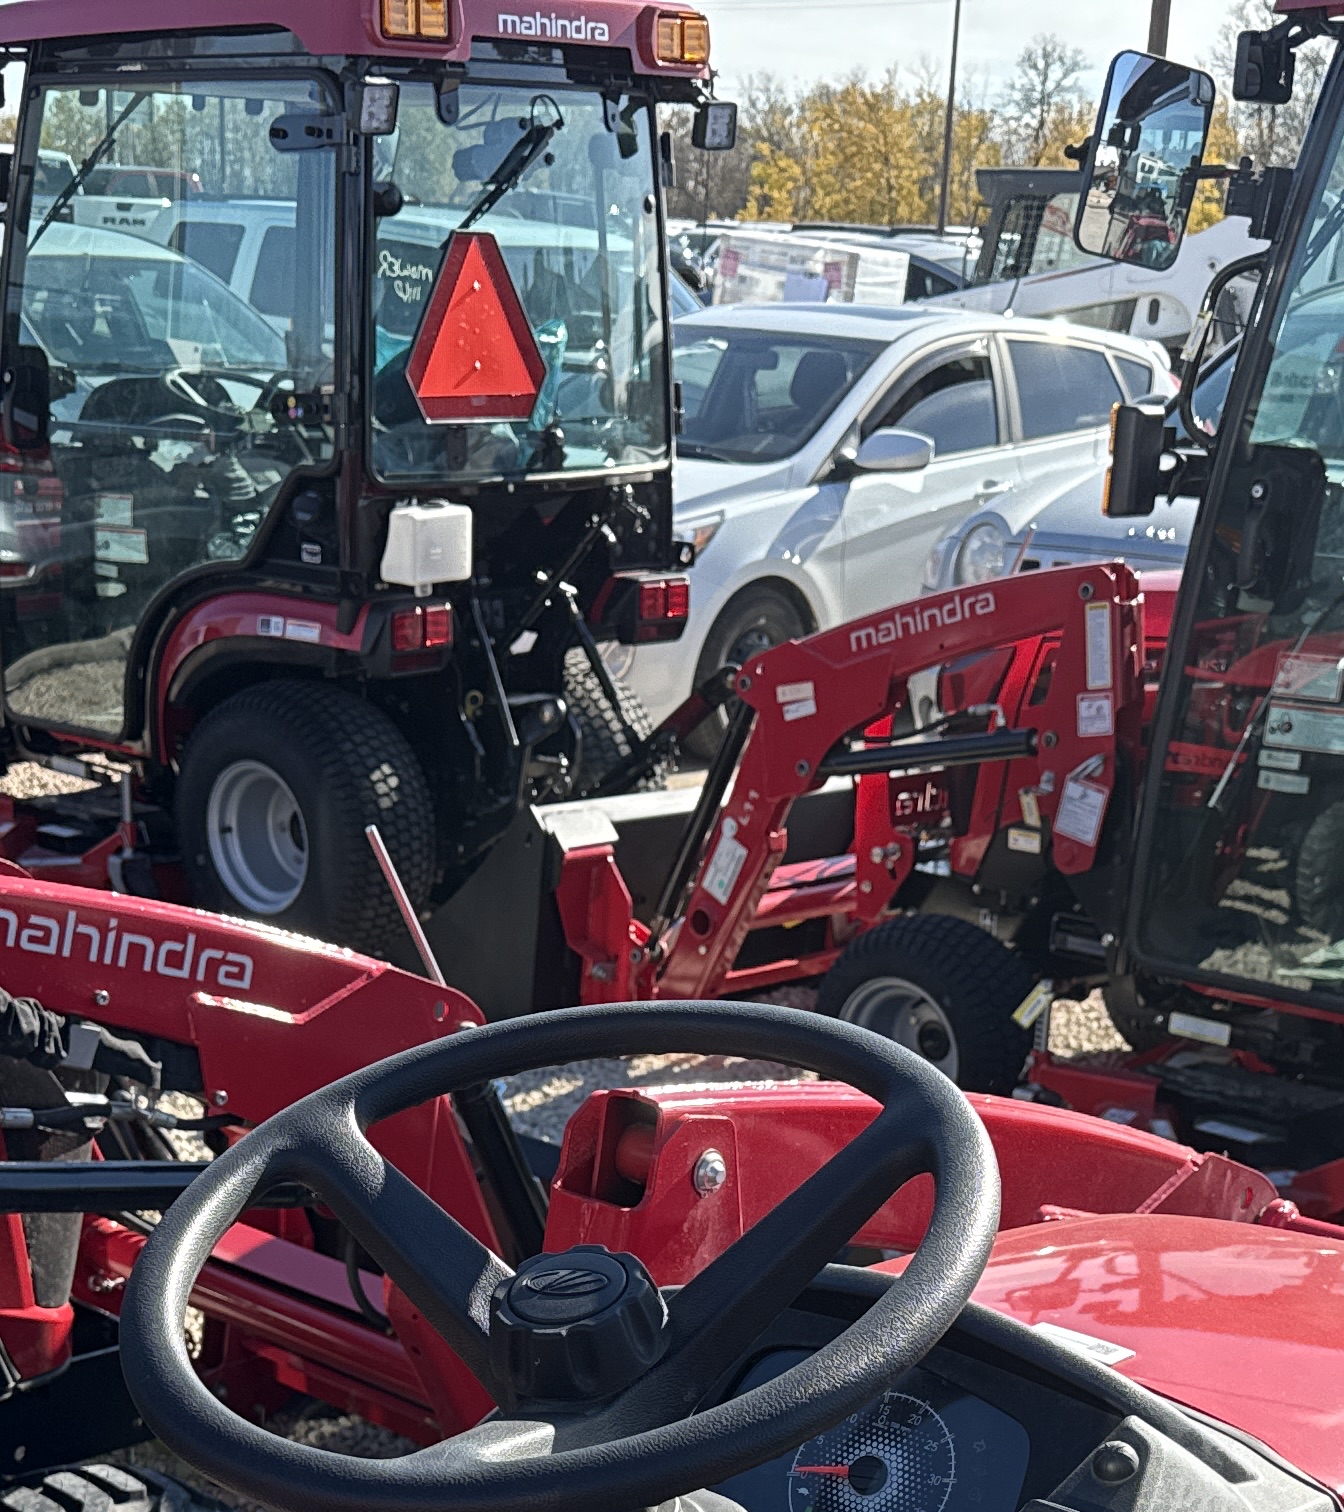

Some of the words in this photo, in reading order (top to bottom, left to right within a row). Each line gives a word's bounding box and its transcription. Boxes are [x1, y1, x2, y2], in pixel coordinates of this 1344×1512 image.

[498, 11, 609, 41] mahindra
[102, 216, 146, 226] RAM
[849, 591, 997, 652] mahindra
[878, 1403, 892, 1415] 15
[907, 1414, 922, 1426] 20
[923, 1439, 940, 1452] 25
[927, 1474, 942, 1486] 30
